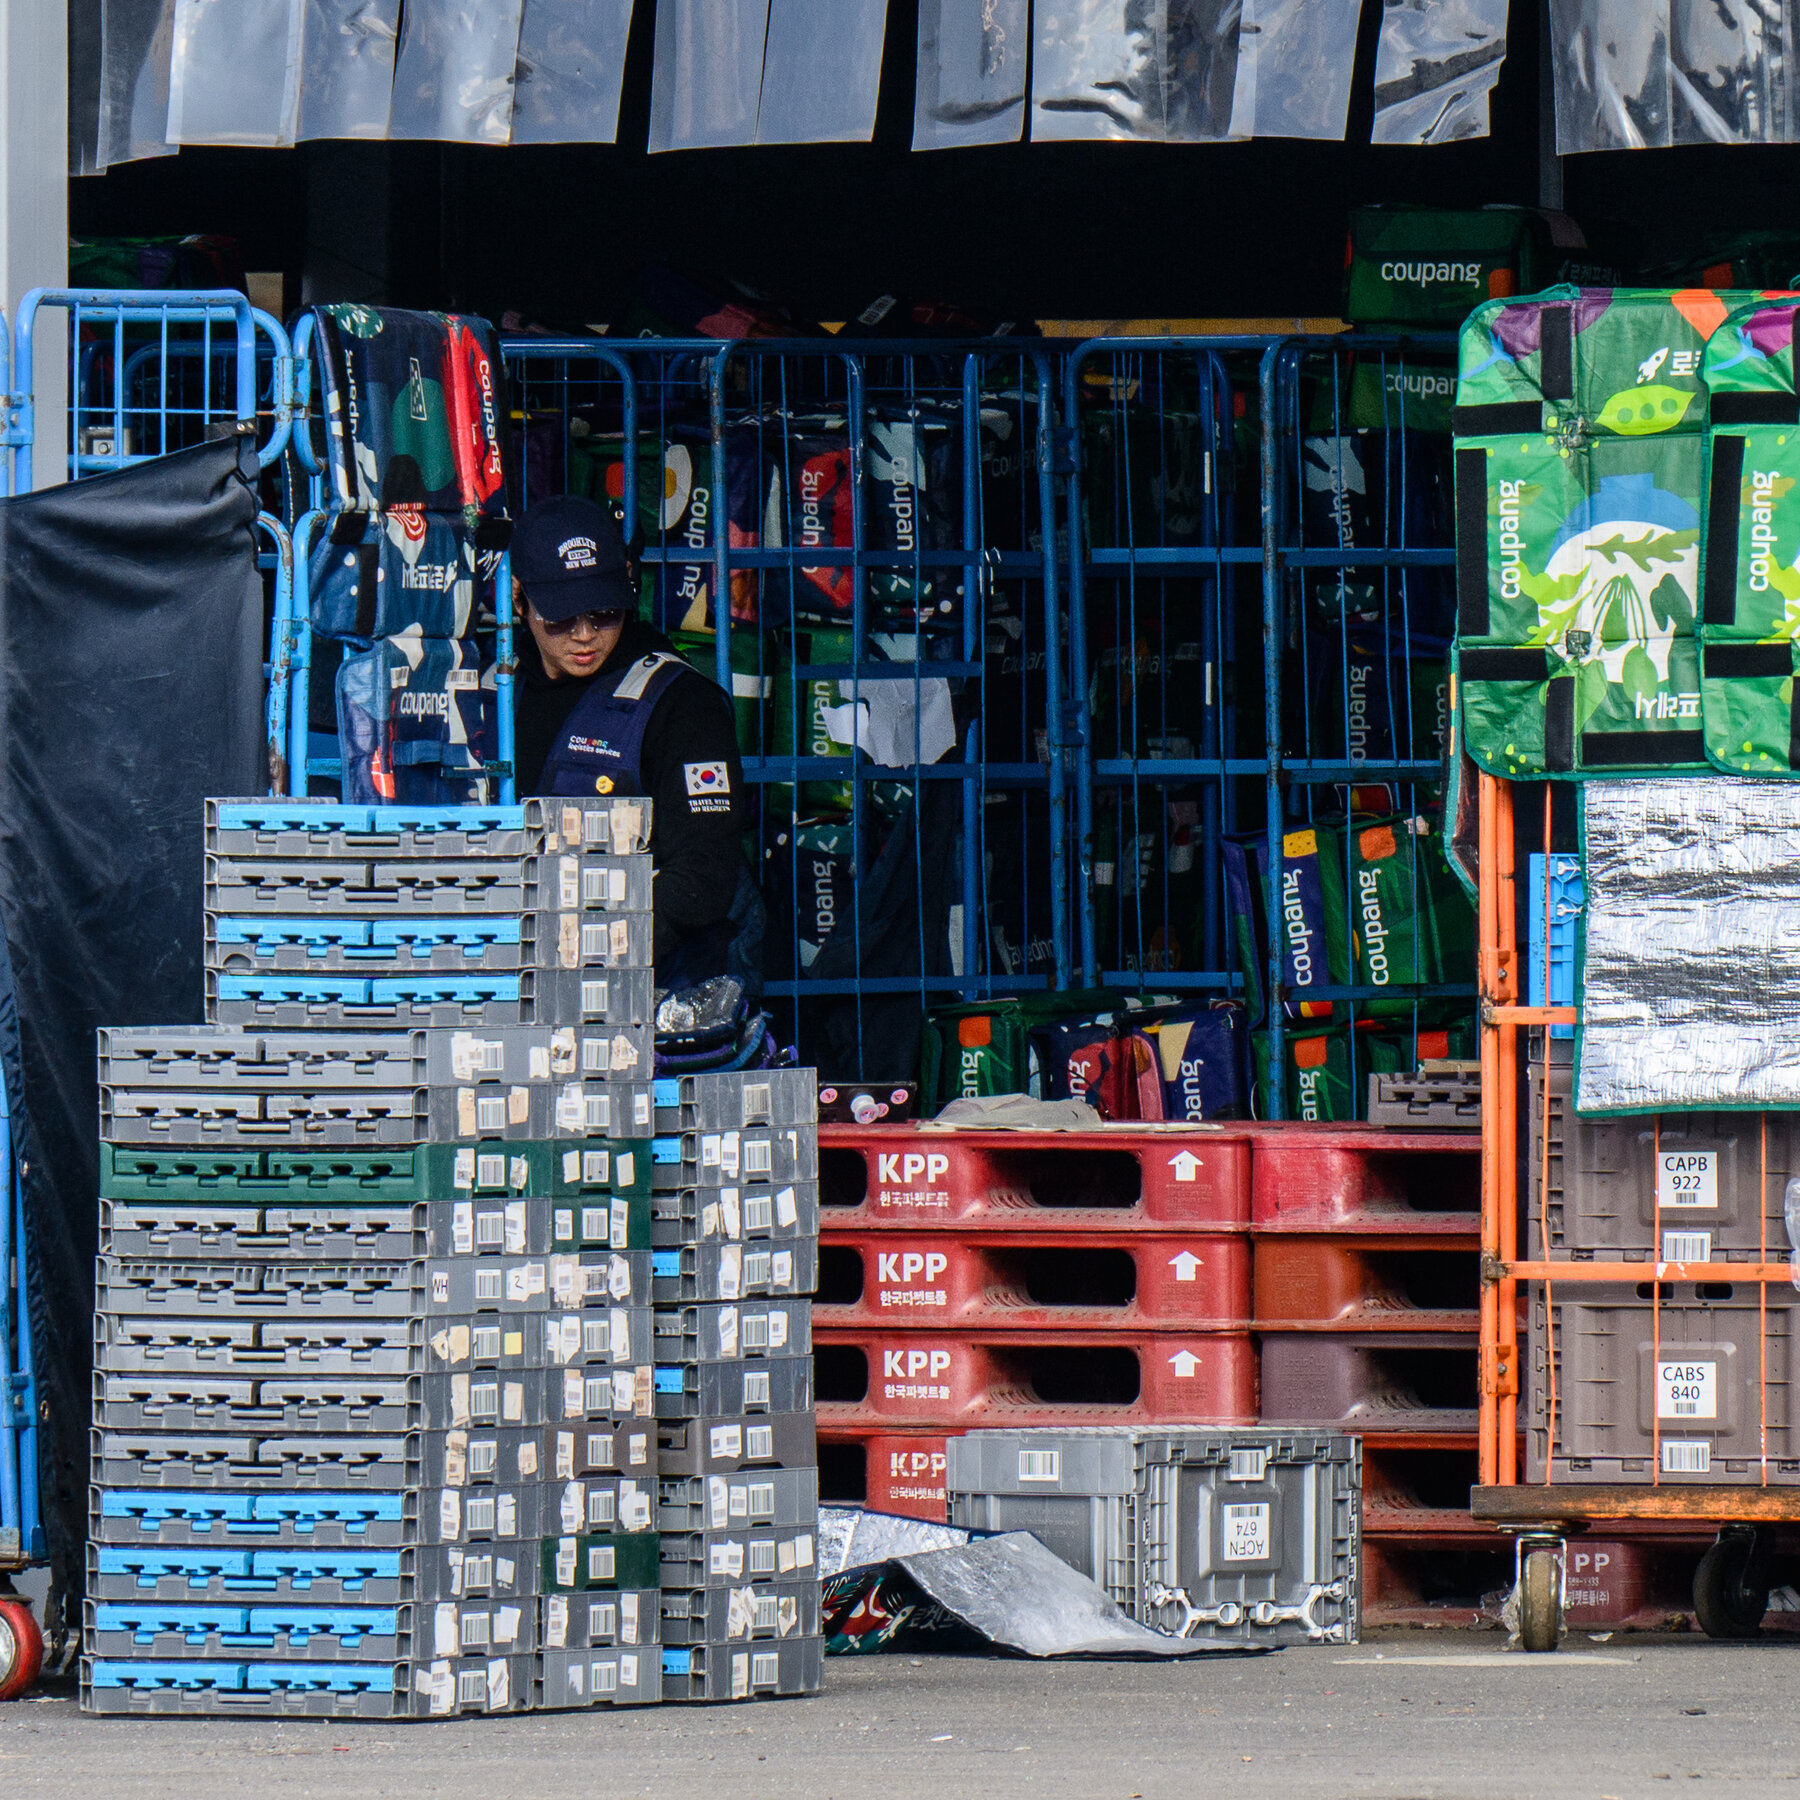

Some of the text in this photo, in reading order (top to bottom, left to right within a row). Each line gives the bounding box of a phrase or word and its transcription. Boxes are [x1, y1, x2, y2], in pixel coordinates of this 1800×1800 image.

[1381, 258, 1482, 289] coupang
[1385, 372, 1457, 397] coupan
[479, 359, 502, 475] coupang
[890, 456, 914, 551] coupan
[677, 486, 710, 600] coupng
[1498, 479, 1526, 599] coupang
[1748, 470, 1779, 592] coupang
[401, 692, 448, 723] coupang
[1348, 665, 1373, 766] oupang
[570, 735, 608, 748] coupang
[1283, 869, 1312, 986] coupang
[1358, 869, 1389, 986] coupang
[878, 1153, 950, 1183] KPP
[1664, 1155, 1709, 1172] CAPB
[1672, 1175, 1702, 1190] 922
[877, 1253, 948, 1282] KPP
[883, 1350, 951, 1378] KPP
[1662, 1367, 1706, 1383] CABS
[1670, 1386, 1701, 1402] 840
[890, 1453, 947, 1477] KPP
[1236, 1522, 1258, 1536] 674
[1229, 1540, 1265, 1556] ACFN
